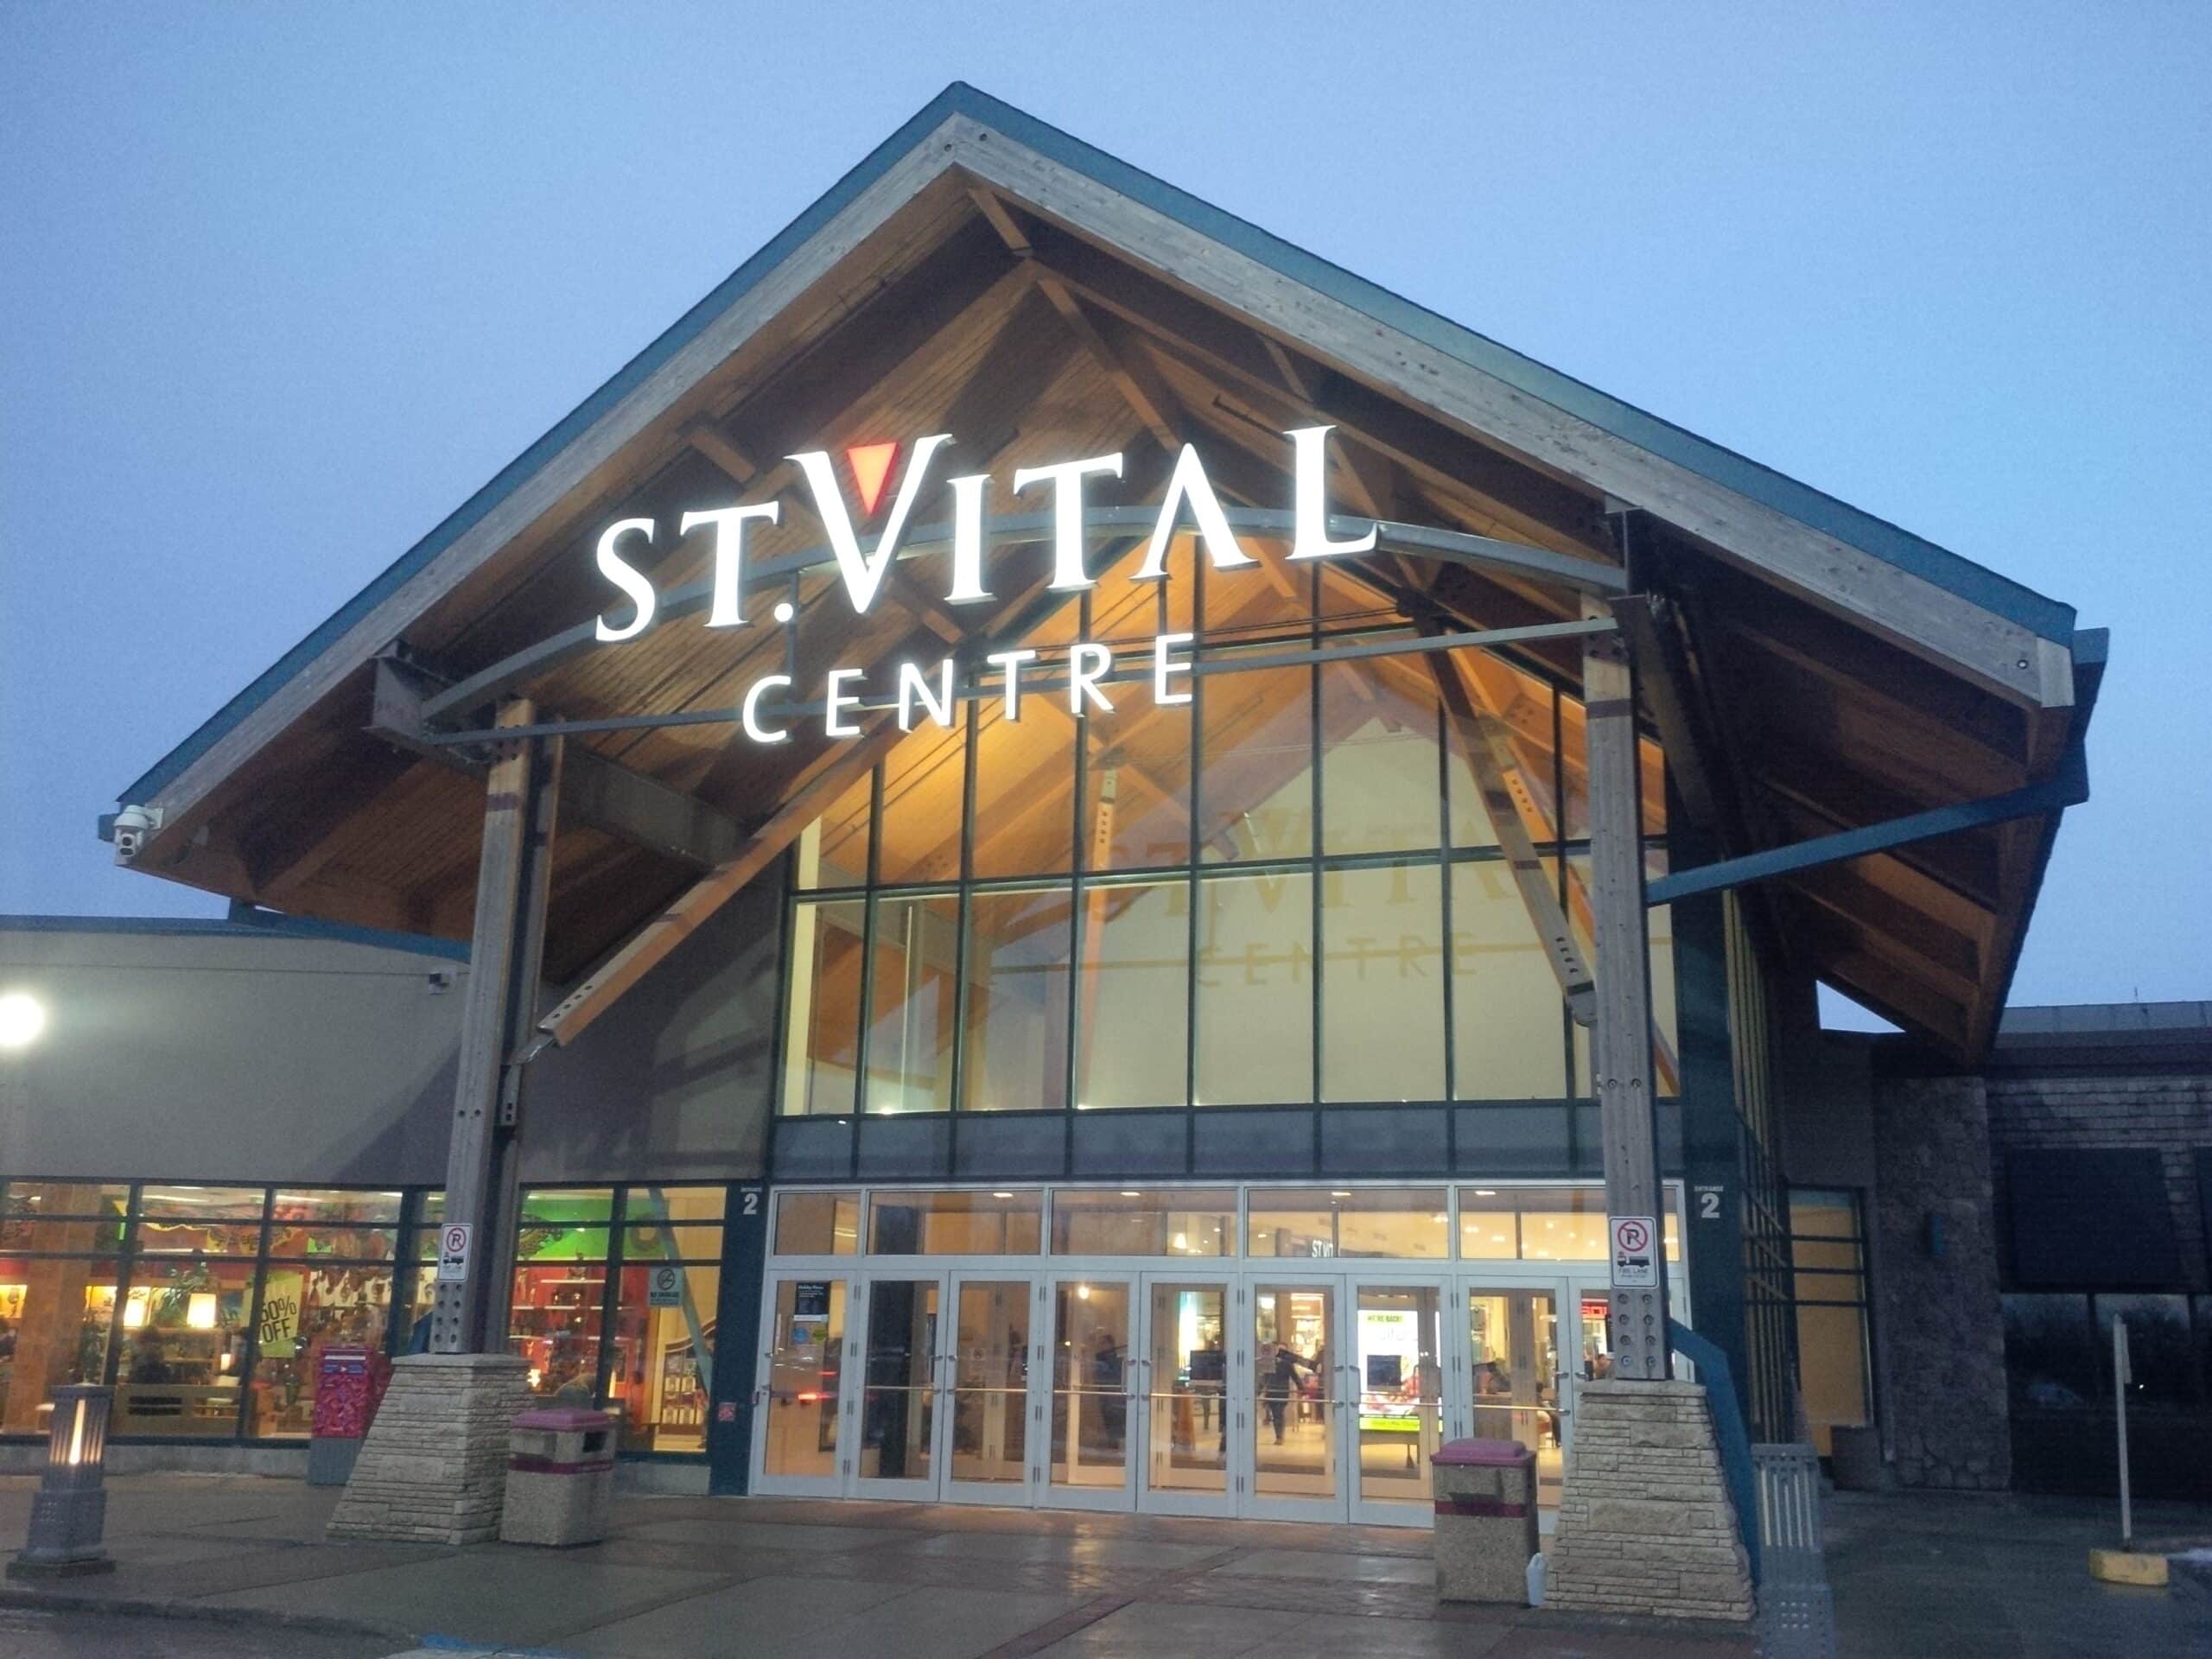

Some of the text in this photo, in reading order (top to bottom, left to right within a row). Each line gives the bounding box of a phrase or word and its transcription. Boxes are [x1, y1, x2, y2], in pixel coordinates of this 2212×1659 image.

[784, 424, 1380, 615] VITAL
[742, 632, 1195, 745] CENTRE
[743, 1193, 758, 1215] 2
[1701, 1192, 1719, 1218] 2
[263, 1318, 290, 1343] OFF
